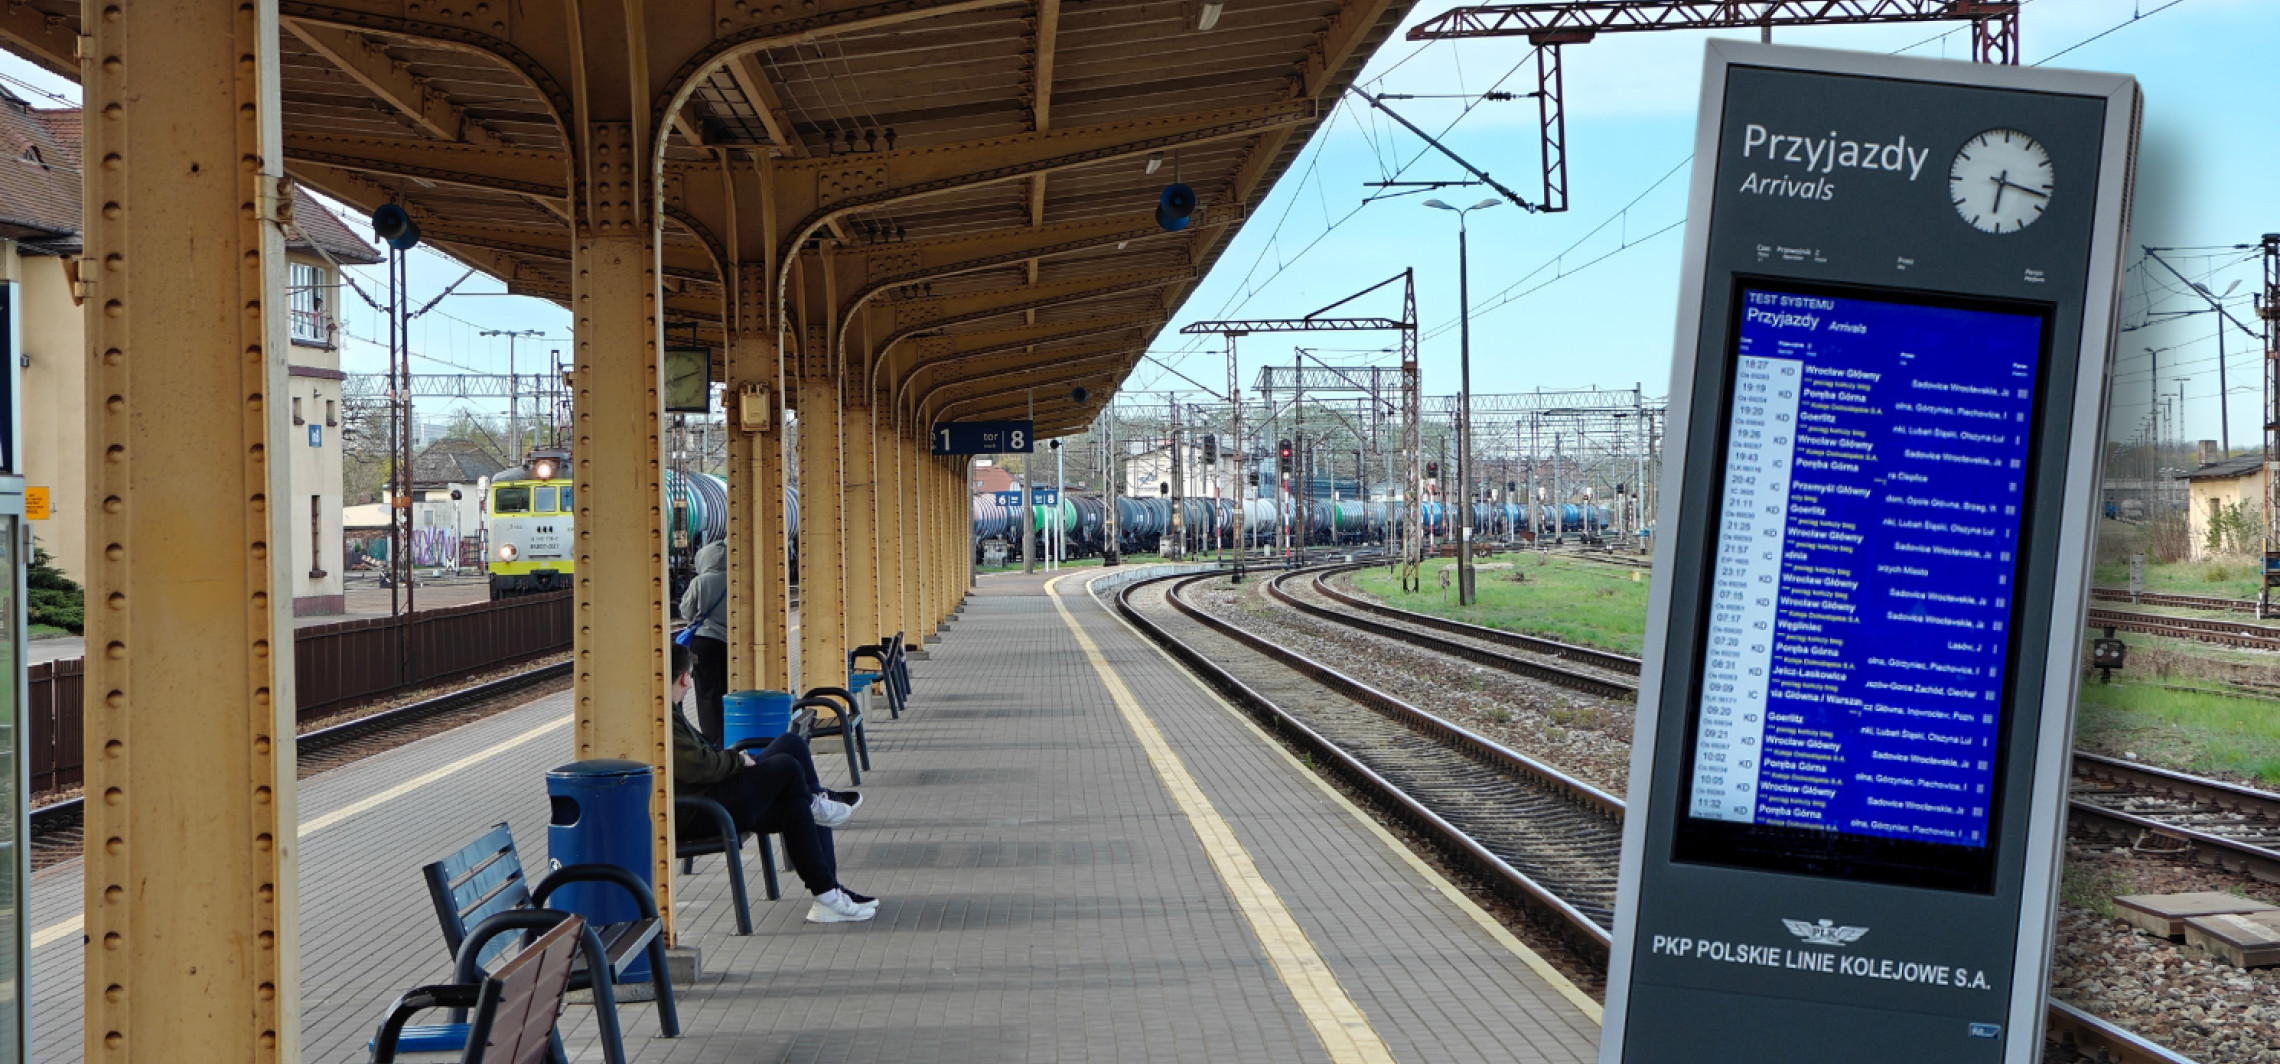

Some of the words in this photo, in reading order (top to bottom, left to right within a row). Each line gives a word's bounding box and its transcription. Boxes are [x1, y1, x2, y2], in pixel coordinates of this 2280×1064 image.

[1744, 124, 1930, 180] Przyjazdy
[1739, 172, 1834, 201] Arrivals
[1749, 292, 1777, 304] TEST
[1780, 296, 1834, 309] SYSTEMU
[1747, 307, 1818, 329] Przyjazdy
[1828, 321, 1866, 333] Arrivals
[1745, 359, 1768, 369] 18:27
[1780, 367, 1794, 376] KD
[1805, 365, 1845, 376] Wrocław
[1845, 368, 1880, 381] Główny
[1743, 382, 1765, 392] 19:19
[1778, 390, 1792, 398] KD
[1740, 405, 1763, 415] 19:20
[1775, 413, 1789, 422] KD
[1800, 411, 1835, 422] Goerlitz
[1738, 428, 1760, 438] 19:26
[940, 428, 950, 451] 1
[1011, 430, 1024, 449] 8
[1773, 436, 1787, 445] KD
[1798, 434, 1837, 445] Wrocław
[1838, 438, 1872, 451] Główny
[1736, 452, 1758, 461] 19:43
[1732, 474, 1755, 485] 20:42
[999, 495, 1006, 505] 6
[1048, 494, 1054, 504] 8
[1729, 497, 1752, 507] 21:11
[1766, 506, 1779, 514] KD
[1790, 503, 1825, 515] Goerlitz
[1726, 520, 1750, 530] 21:25
[1763, 528, 1776, 537] KD
[1788, 527, 1827, 538] Wrocław
[1828, 531, 1863, 543] Główny
[1724, 543, 1748, 553] 21:57
[1721, 566, 1745, 576] 23:17
[1758, 575, 1772, 583] KD
[1783, 573, 1822, 584] Wrocław
[1822, 577, 1858, 589] Główny
[1755, 598, 1769, 606] KD
[1780, 596, 1820, 607] Wrocław
[1820, 600, 1855, 613] Główny
[1753, 621, 1767, 630] KD
[1713, 636, 1738, 646] 07:20
[1751, 644, 1764, 653] KD
[1748, 667, 1762, 676] KD
[1706, 705, 1731, 715] 09:20
[1743, 713, 1757, 722] KD
[1767, 711, 1803, 723] Goerlitz
[1703, 728, 1727, 738] 09:21
[1741, 736, 1755, 745] KD
[1766, 735, 1805, 746] Wrocław
[1805, 738, 1840, 751] Główny
[1703, 752, 1725, 762] 10:02
[1738, 760, 1752, 768] KD
[1736, 783, 1750, 792] KD
[1760, 781, 1799, 792] Wrocław
[1801, 785, 1835, 798] Główny
[1698, 798, 1721, 808] 11:32
[1733, 806, 1747, 815] KD
[1652, 936, 1692, 957] PKP
[1696, 939, 1780, 967] POLSKIE
[1785, 950, 1834, 972] LINIE
[1840, 954, 1949, 985] KOLEJOWE
[1954, 966, 1992, 990] S.A.
